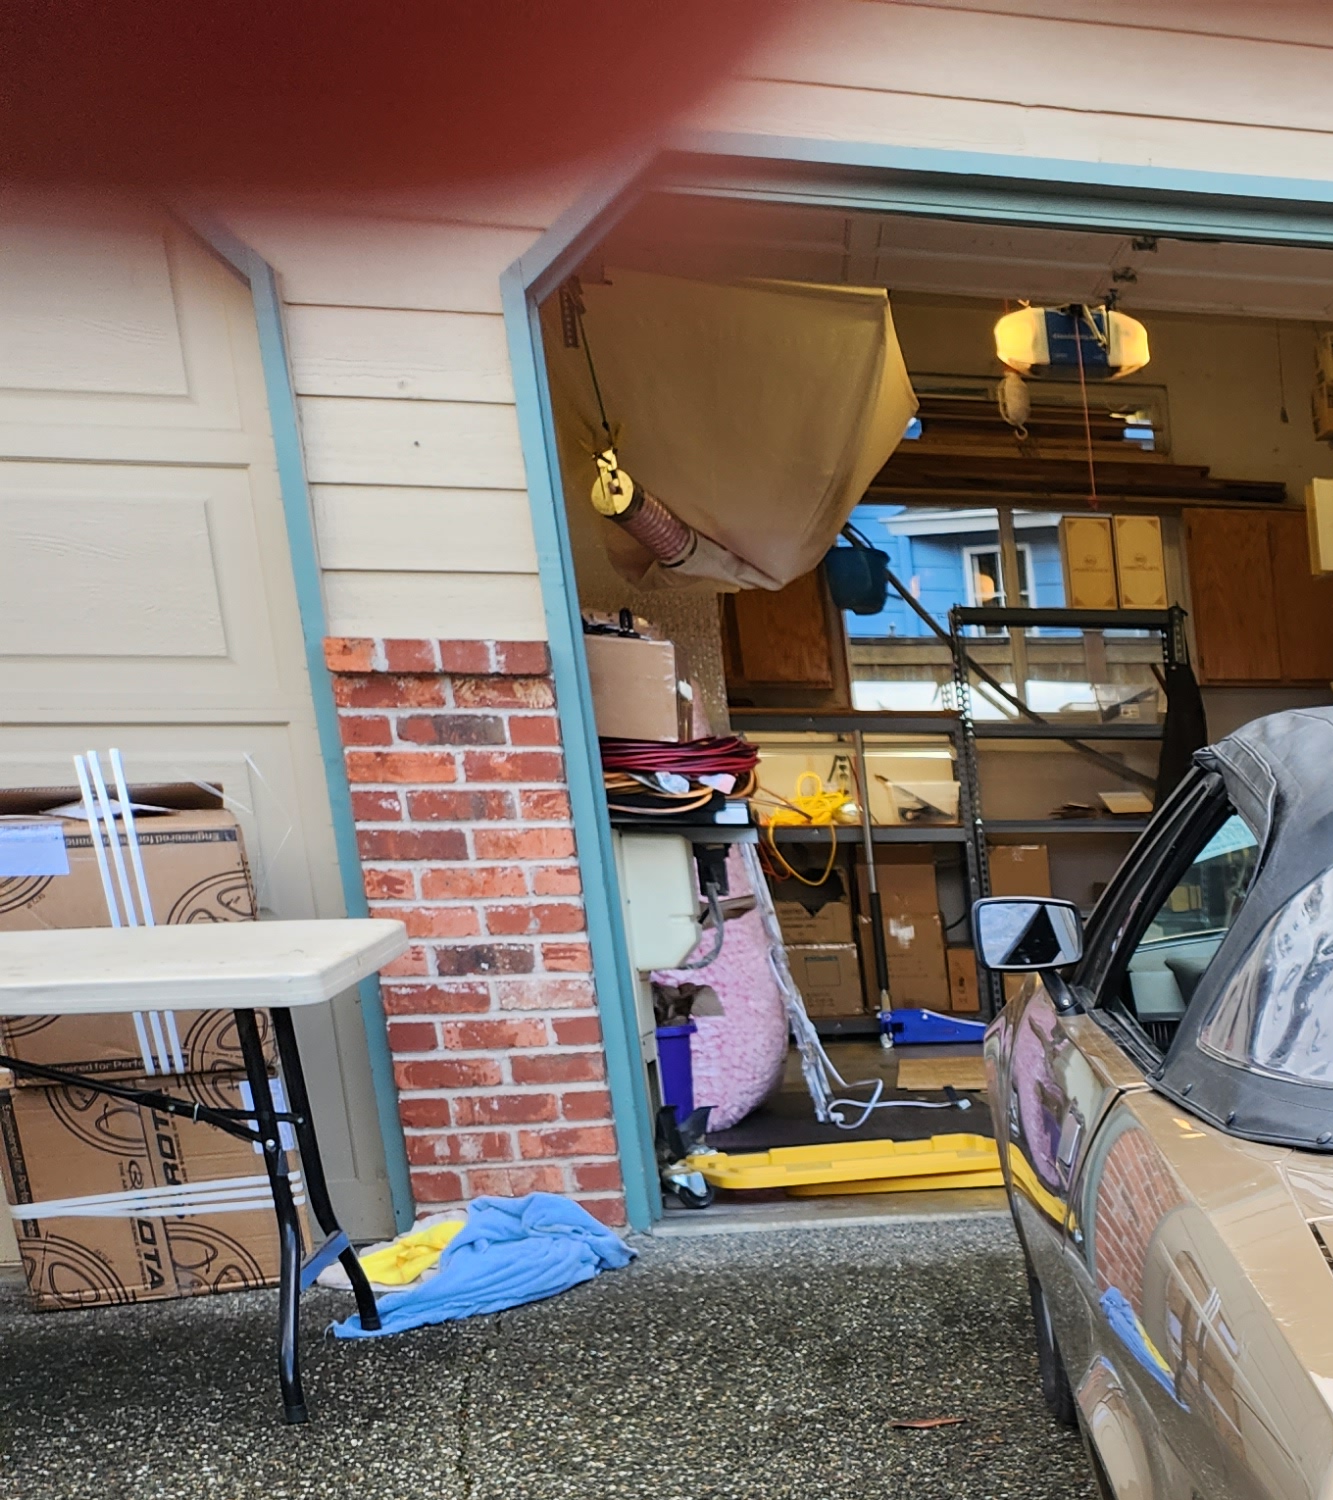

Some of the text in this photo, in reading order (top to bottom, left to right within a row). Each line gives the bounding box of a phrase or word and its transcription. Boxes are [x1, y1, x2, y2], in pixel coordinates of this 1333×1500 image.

[157, 829, 220, 844] Engineered
[94, 1060, 112, 1071] for
[150, 1088, 182, 1186] ROT
[137, 1217, 165, 1291] OTA
